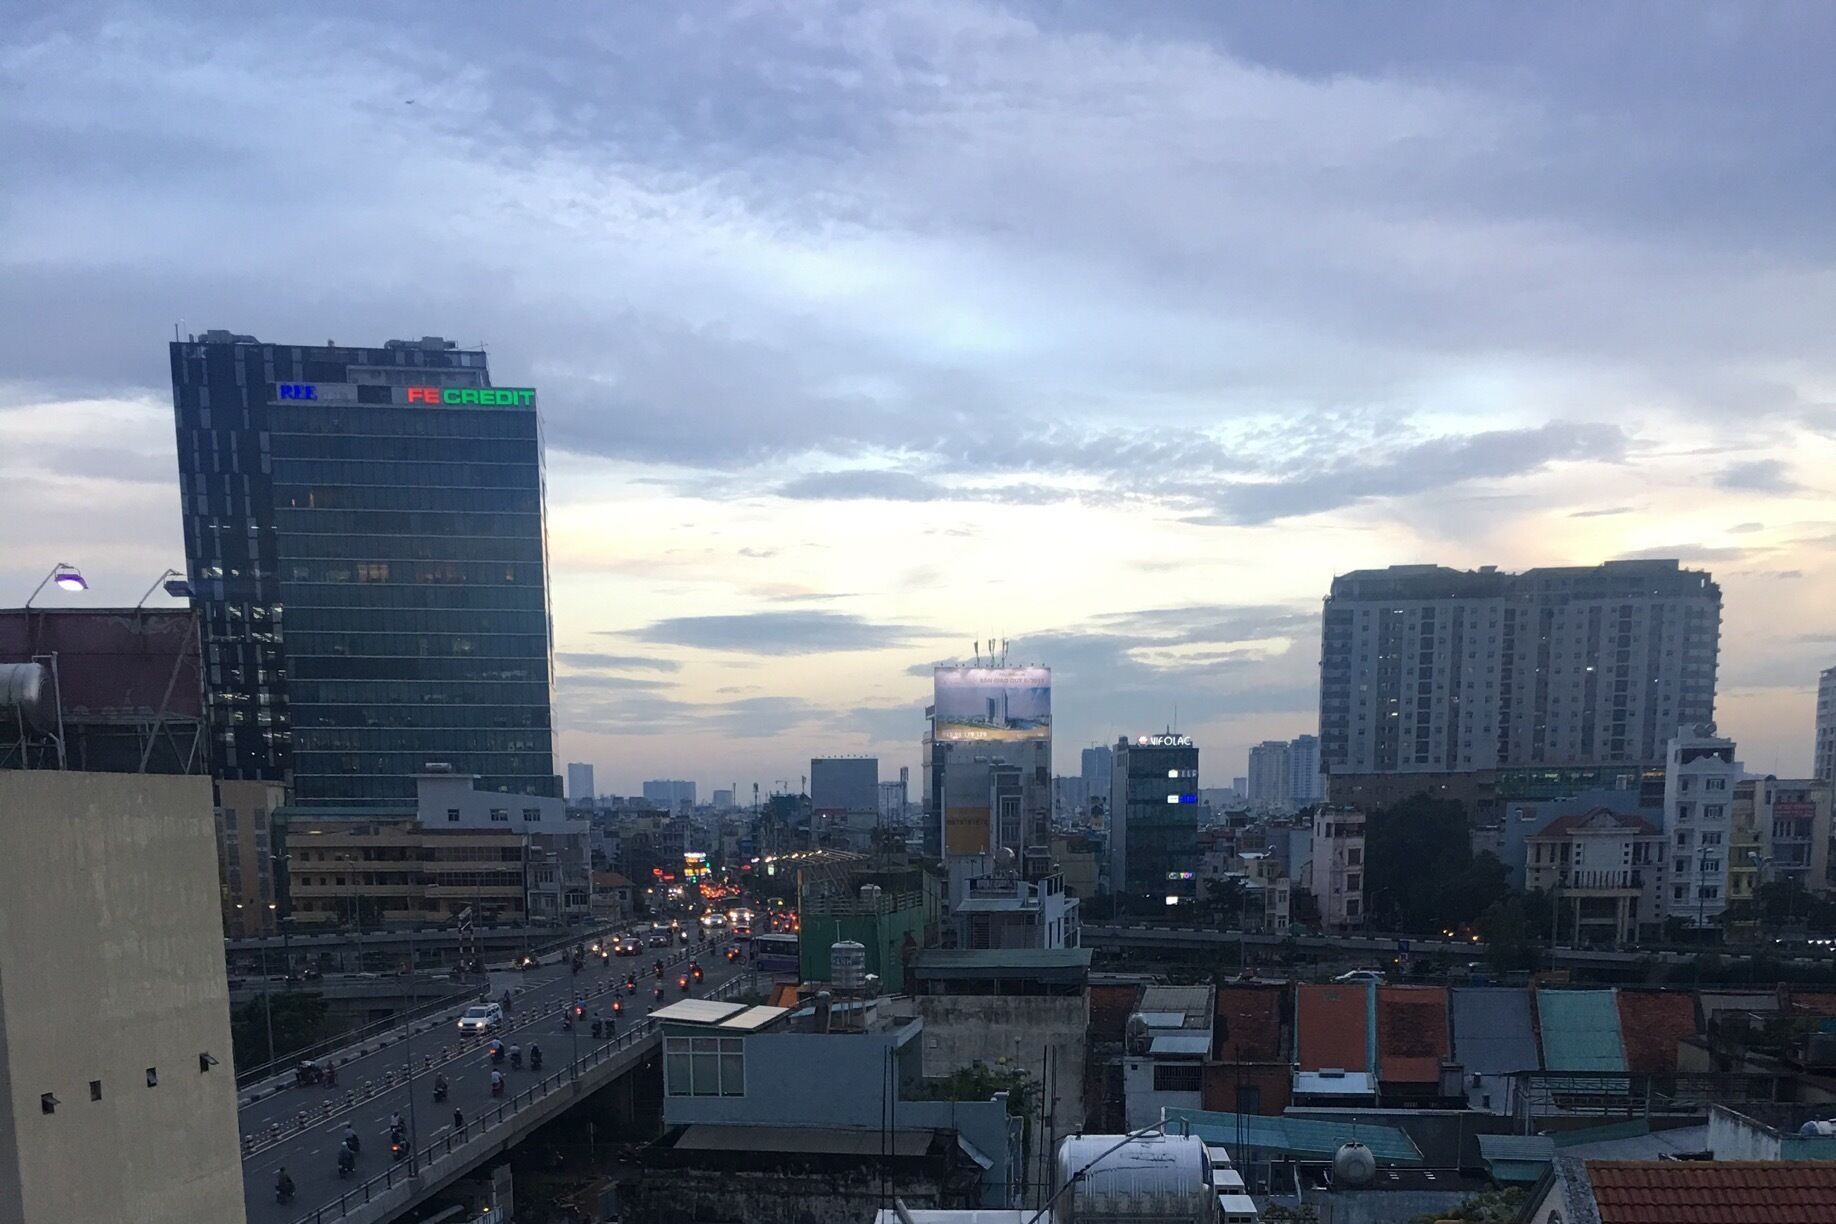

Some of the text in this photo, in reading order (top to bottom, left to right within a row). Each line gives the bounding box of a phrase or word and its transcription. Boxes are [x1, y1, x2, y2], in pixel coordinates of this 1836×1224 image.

[408, 388, 534, 406] FE CREDIT
[1150, 736, 1192, 746] VIFOLAC
